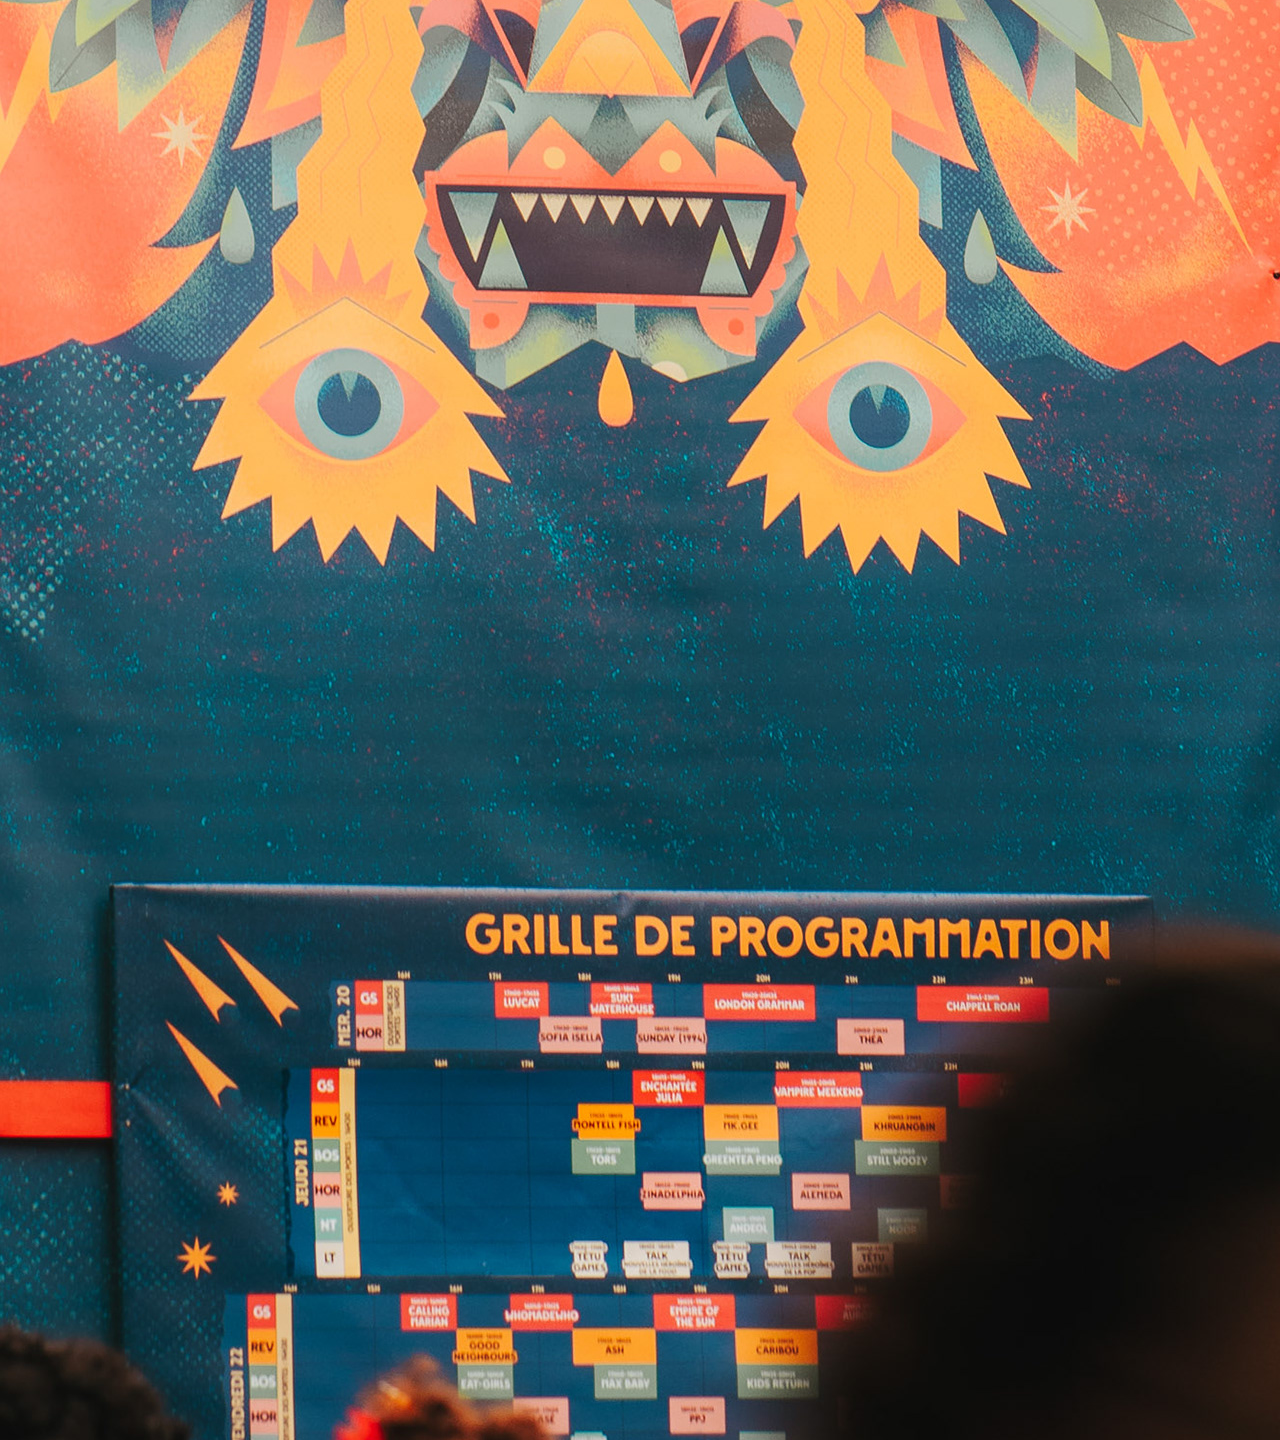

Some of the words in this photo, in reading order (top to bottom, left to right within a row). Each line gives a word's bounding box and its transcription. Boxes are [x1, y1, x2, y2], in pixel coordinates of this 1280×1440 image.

[465, 913, 619, 955] GRILLE
[635, 915, 696, 957] DE
[710, 915, 1111, 961] PROGRAMMATION
[489, 972, 502, 982] 17H
[756, 974, 770, 983] 20H
[336, 985, 350, 1006] 20
[360, 991, 378, 1006] GS
[610, 993, 634, 1004] SUKI
[503, 997, 540, 1009] LUVCAT
[590, 1003, 654, 1015] WATERHOUSE
[714, 999, 754, 1011] LONDON
[757, 999, 805, 1011] GRAMMAR
[946, 1001, 994, 1013] CHAPPELL
[996, 1001, 1021, 1013] ROAN
[337, 1009, 351, 1047] MER.
[357, 1027, 382, 1039] HOR
[540, 1033, 568, 1043] SOFIA
[572, 1033, 603, 1043] ISELLA
[638, 1033, 675, 1043] SUNDAY
[678, 1033, 707, 1044] (1994)
[859, 1033, 883, 1044] THÉA
[316, 1079, 335, 1094] GS
[640, 1078, 697, 1092] ENCHANTÉE
[775, 1085, 815, 1097] VAMPIRE
[817, 1086, 863, 1098] WEEKEND
[655, 1092, 683, 1104] JULIA
[314, 1115, 337, 1127] REV
[573, 1119, 615, 1130] MONTELL
[618, 1119, 640, 1130] FISH
[874, 1121, 936, 1132] KHRUANGBIN
[294, 1138, 308, 1156] 21
[314, 1149, 339, 1163] BOS
[591, 1154, 617, 1166] TORS
[704, 1155, 751, 1166] GREENTEA
[753, 1155, 782, 1166] PENG
[867, 1155, 890, 1166] STILL
[892, 1155, 928, 1167] WOOZY
[295, 1159, 309, 1208] JEUDI
[315, 1184, 340, 1196] HOR
[642, 1189, 704, 1200] ZINADELPHIA
[800, 1189, 843, 1200] ALEMEDA
[320, 1218, 337, 1232] NT
[324, 1253, 335, 1264] LT
[646, 1252, 668, 1260] TALK
[789, 1252, 810, 1261] TALK
[253, 1305, 271, 1319] GS
[408, 1305, 450, 1317] CALLING
[505, 1309, 579, 1321] WHOMADEWHO
[670, 1305, 704, 1317] EMPIRE
[706, 1305, 720, 1317] OF
[410, 1316, 449, 1328] MARIAN
[674, 1316, 693, 1327] THE
[696, 1316, 715, 1328] SUN
[251, 1341, 274, 1353] REV
[469, 1340, 500, 1351] GOOD
[605, 1344, 625, 1355] ASH
[756, 1345, 799, 1356] CARIBOU
[229, 1347, 244, 1368] 22
[454, 1351, 517, 1362] NEIGHBOURS
[251, 1374, 276, 1389] BOS
[460, 1378, 510, 1390] EAT-GIRLS
[601, 1378, 622, 1389] MAX
[624, 1378, 650, 1390] BABY
[746, 1377, 770, 1390] KIDS
[773, 1378, 810, 1390] RETURN
[251, 1411, 277, 1423] HOR
